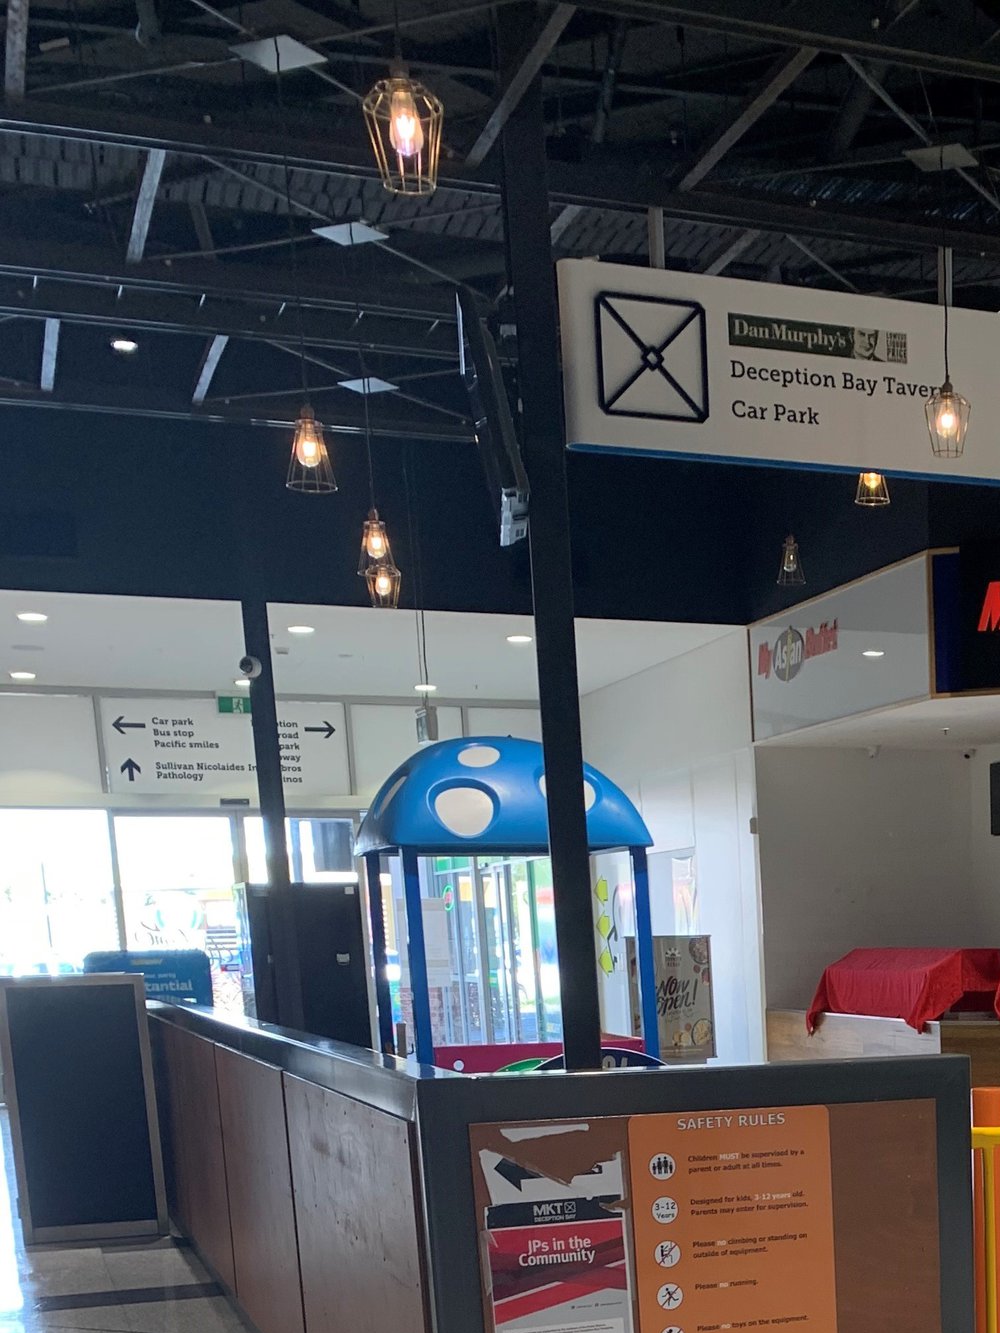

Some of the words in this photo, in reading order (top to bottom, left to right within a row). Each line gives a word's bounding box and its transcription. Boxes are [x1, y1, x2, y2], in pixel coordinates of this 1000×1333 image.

[734, 318, 769, 339] Dan
[771, 322, 846, 351] Murphy's
[730, 360, 836, 388] Deception
[842, 372, 877, 396] Bay
[731, 400, 767, 420] Car
[774, 403, 819, 425] Park
[151, 717, 169, 725] Car
[171, 717, 194, 727] park
[153, 728, 171, 737] Bus
[173, 729, 195, 738] stop
[154, 739, 186, 748] Pacific
[188, 740, 220, 749] smiles
[155, 761, 194, 770] Sullivan
[196, 762, 245, 772] Nicolaides
[156, 771, 204, 781] Pathology
[144, 979, 193, 993] tantial
[677, 1116, 733, 1130] SAFETY
[738, 1113, 785, 1127] RULES
[688, 1154, 718, 1163] Children
[719, 1152, 740, 1161] MUST
[751, 1149, 789, 1159] supervised
[688, 1165, 712, 1174] parent
[722, 1163, 741, 1171] adult
[762, 1160, 782, 1168] times.
[655, 1201, 676, 1211] 3-12
[690, 1196, 723, 1206] Designed
[771, 1192, 791, 1201] years
[533, 1202, 563, 1217] MKT
[656, 1211, 675, 1220] Years
[690, 1207, 718, 1216] Parents
[736, 1204, 755, 1212] enter
[756, 1203, 767, 1211] for
[768, 1201, 808, 1210] supervision.
[534, 1214, 565, 1223] DECEPTION
[528, 1239, 549, 1256] JPs
[552, 1237, 565, 1251] in
[569, 1235, 591, 1250] the
[692, 1240, 716, 1248] Please
[728, 1236, 757, 1245] climbing
[767, 1232, 798, 1241] standing
[518, 1247, 595, 1267] Community
[693, 1250, 719, 1259] outside
[729, 1246, 769, 1256] equipment.
[695, 1282, 718, 1290] Please
[697, 1324, 720, 1332] Please
[731, 1321, 746, 1329] toys
